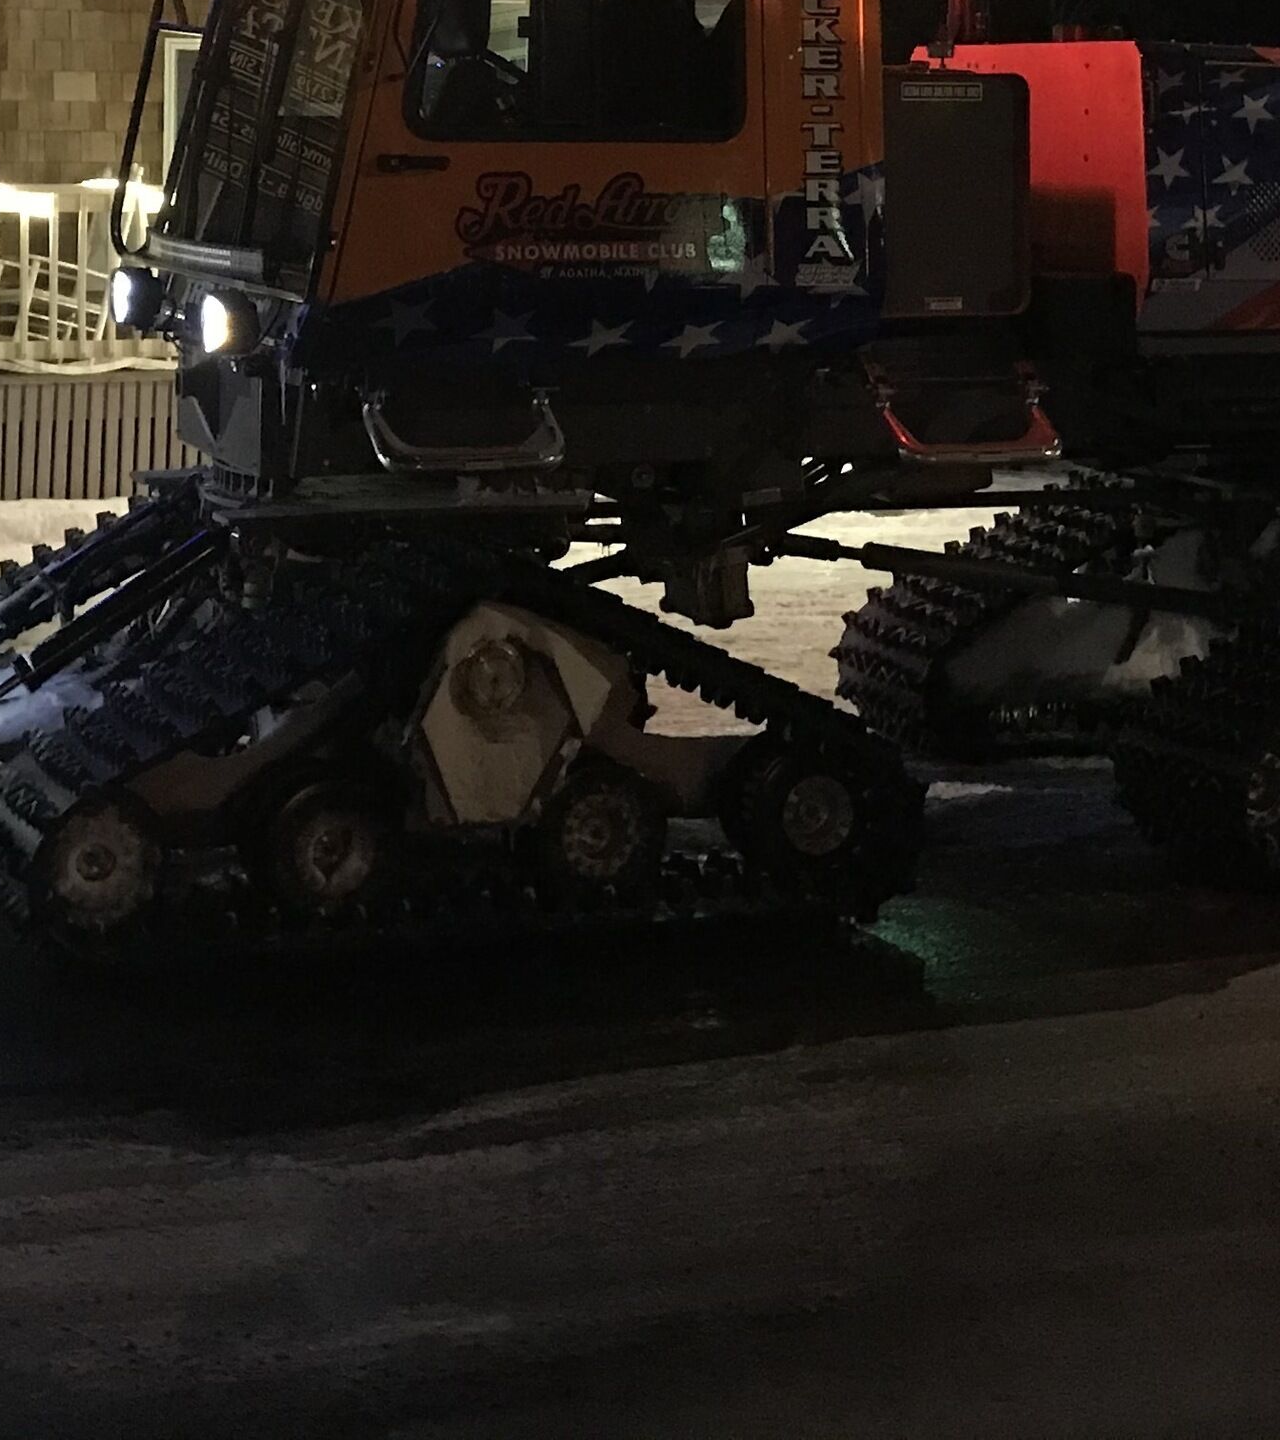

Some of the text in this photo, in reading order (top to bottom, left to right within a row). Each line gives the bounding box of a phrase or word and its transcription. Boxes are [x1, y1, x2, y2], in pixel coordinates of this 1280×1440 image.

[456, 170, 592, 244] Red
[495, 242, 697, 260] SNOWMOBILE CLUB
